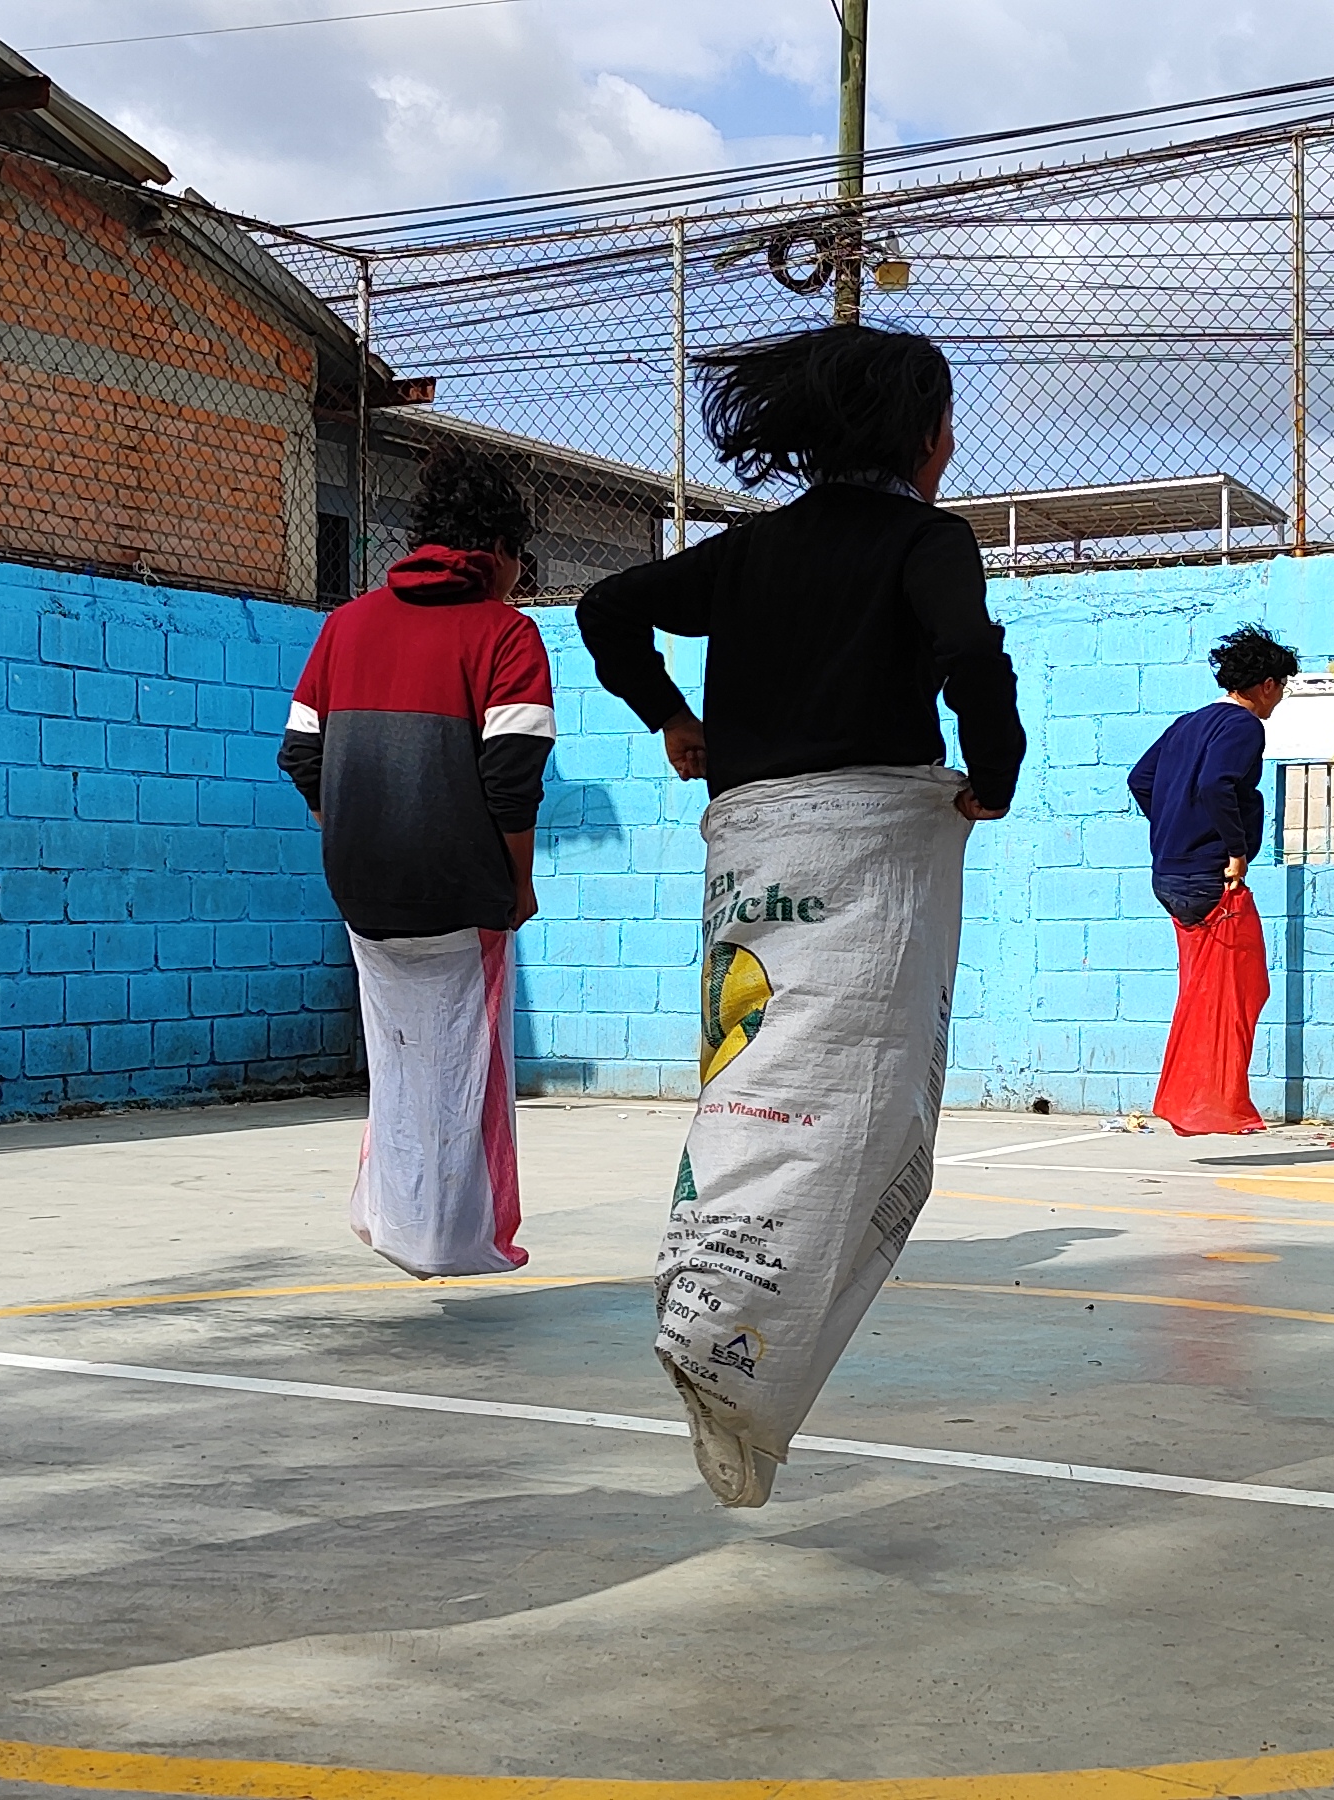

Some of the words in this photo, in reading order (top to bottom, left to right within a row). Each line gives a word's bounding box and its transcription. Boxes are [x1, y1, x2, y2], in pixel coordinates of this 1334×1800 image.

[710, 869, 735, 901] El
[704, 1102, 723, 1114] con
[727, 1101, 790, 1124] Vitamina
[689, 1257, 781, 1297] Cantarranas,
[754, 1252, 788, 1272] S.A.
[677, 1276, 696, 1294] 50
[698, 1287, 722, 1313] Kg
